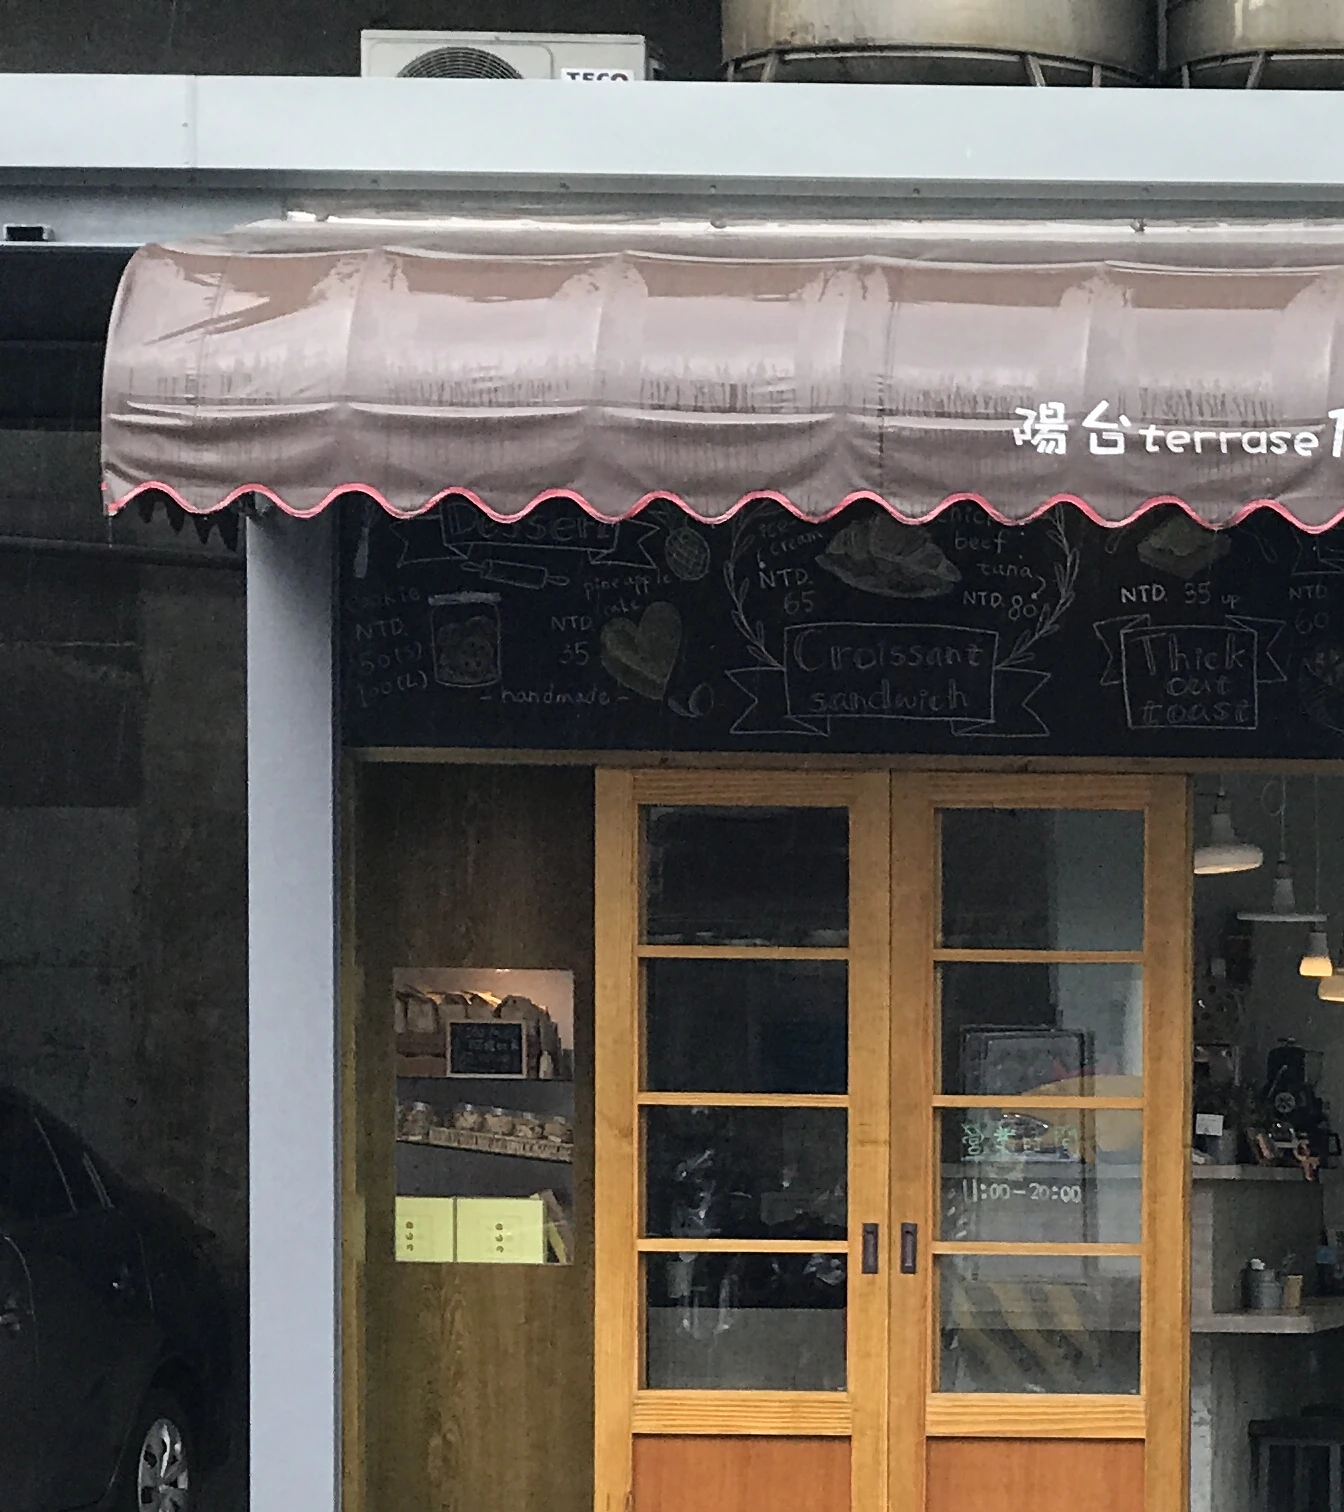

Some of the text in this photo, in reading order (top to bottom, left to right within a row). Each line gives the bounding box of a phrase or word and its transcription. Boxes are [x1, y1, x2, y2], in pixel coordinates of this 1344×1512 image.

[1138, 422, 1320, 457] terrase
[783, 590, 815, 615] 65
[1007, 594, 1037, 621] 80
[1220, 593, 1242, 611] up
[794, 627, 986, 673] Croissant
[1128, 630, 1248, 676] Thick
[500, 684, 611, 706] handmade
[808, 678, 970, 714] sandwich
[1139, 702, 1254, 726] toast
